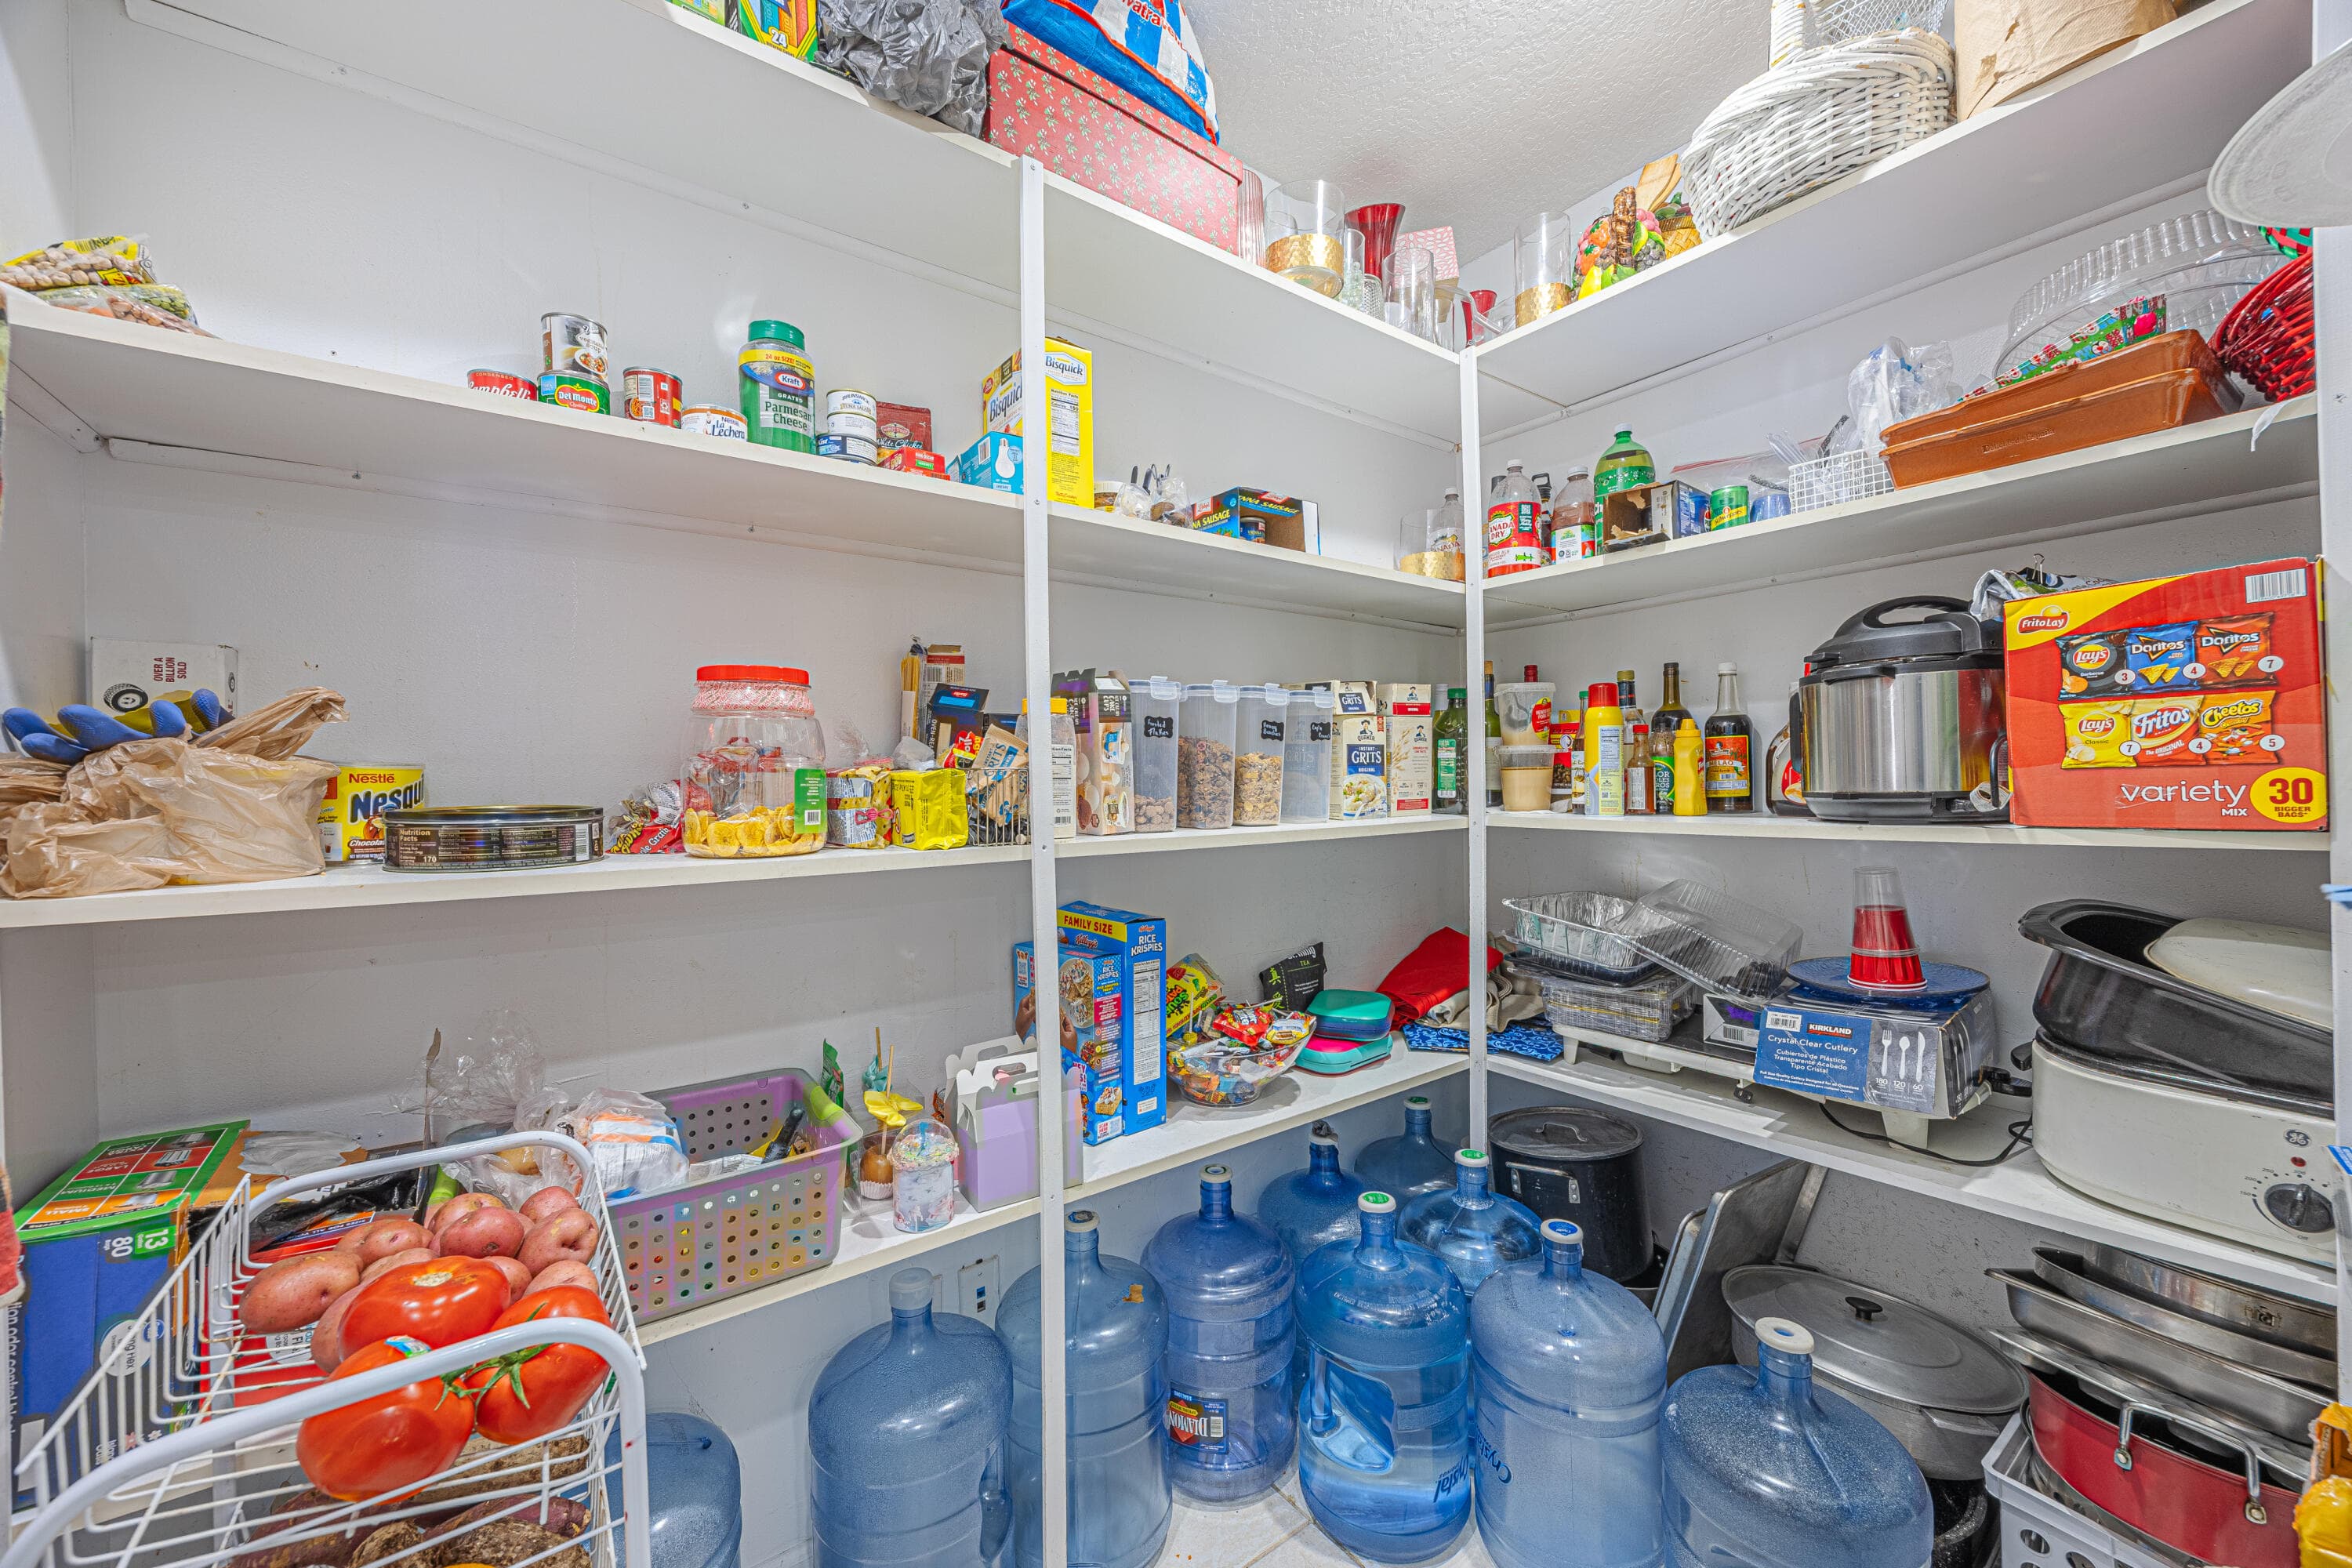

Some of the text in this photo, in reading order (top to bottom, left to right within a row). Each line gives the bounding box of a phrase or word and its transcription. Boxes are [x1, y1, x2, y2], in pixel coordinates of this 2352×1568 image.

[771, 29, 787, 48] 24
[1045, 356, 1083, 376] Bisquick
[782, 376, 800, 387] Kraft
[558, 391, 597, 406] Del Monte
[777, 393, 804, 403] GRATED
[764, 401, 812, 423] Parmesan
[773, 413, 808, 430] Cheese
[712, 424, 745, 440] Lechera
[895, 438, 923, 450] Chicken
[1260, 501, 1300, 514] SAUSAGE
[1203, 510, 1231, 526] SAUSAGE
[1490, 531, 1505, 540] DRY
[2132, 640, 2184, 654] Doritos
[2201, 633, 2259, 647] Doritos
[2075, 650, 2108, 664] Lay's
[2267, 660, 2273, 669] 7
[154, 664, 163, 682] OVER
[165, 657, 175, 683] BILLION
[177, 662, 187, 679] SOLD
[1342, 696, 1363, 706] GRITS
[2132, 706, 2190, 737] Fritos
[2203, 700, 2261, 728] Cheetos
[2080, 717, 2113, 732] Lay's
[2154, 740, 2185, 755] ORIGINAL
[2197, 742, 2203, 750] 4
[1352, 751, 1381, 765] GRITS
[2121, 779, 2246, 807] variety
[2269, 778, 2314, 806] 30
[2221, 808, 2248, 816] MIX
[648, 827, 670, 845] Grain
[1064, 915, 1113, 935] FAMILY SIZE
[1075, 933, 1098, 949] Kellogg's
[1138, 934, 1156, 945] RICE
[1131, 942, 1163, 957] KRISPIES
[1098, 970, 1119, 981] KRISPIES
[1809, 1024, 1852, 1035] KIRKLAND
[1768, 1035, 1858, 1055] Crystal Clear Cutlery
[1774, 1055, 1848, 1070] Transparente Acabado
[1776, 1049, 1809, 1058] Cubiertos
[1820, 1054, 1846, 1064] Plástico
[1806, 1065, 1828, 1073] Cristal
[59, 1184, 117, 1195] MEDIUM
[45, 1206, 91, 1215] SMALL
[111, 1236, 133, 1258] 80
[145, 1229, 169, 1250] 13
[1169, 1410, 1208, 1437] DIAMON
